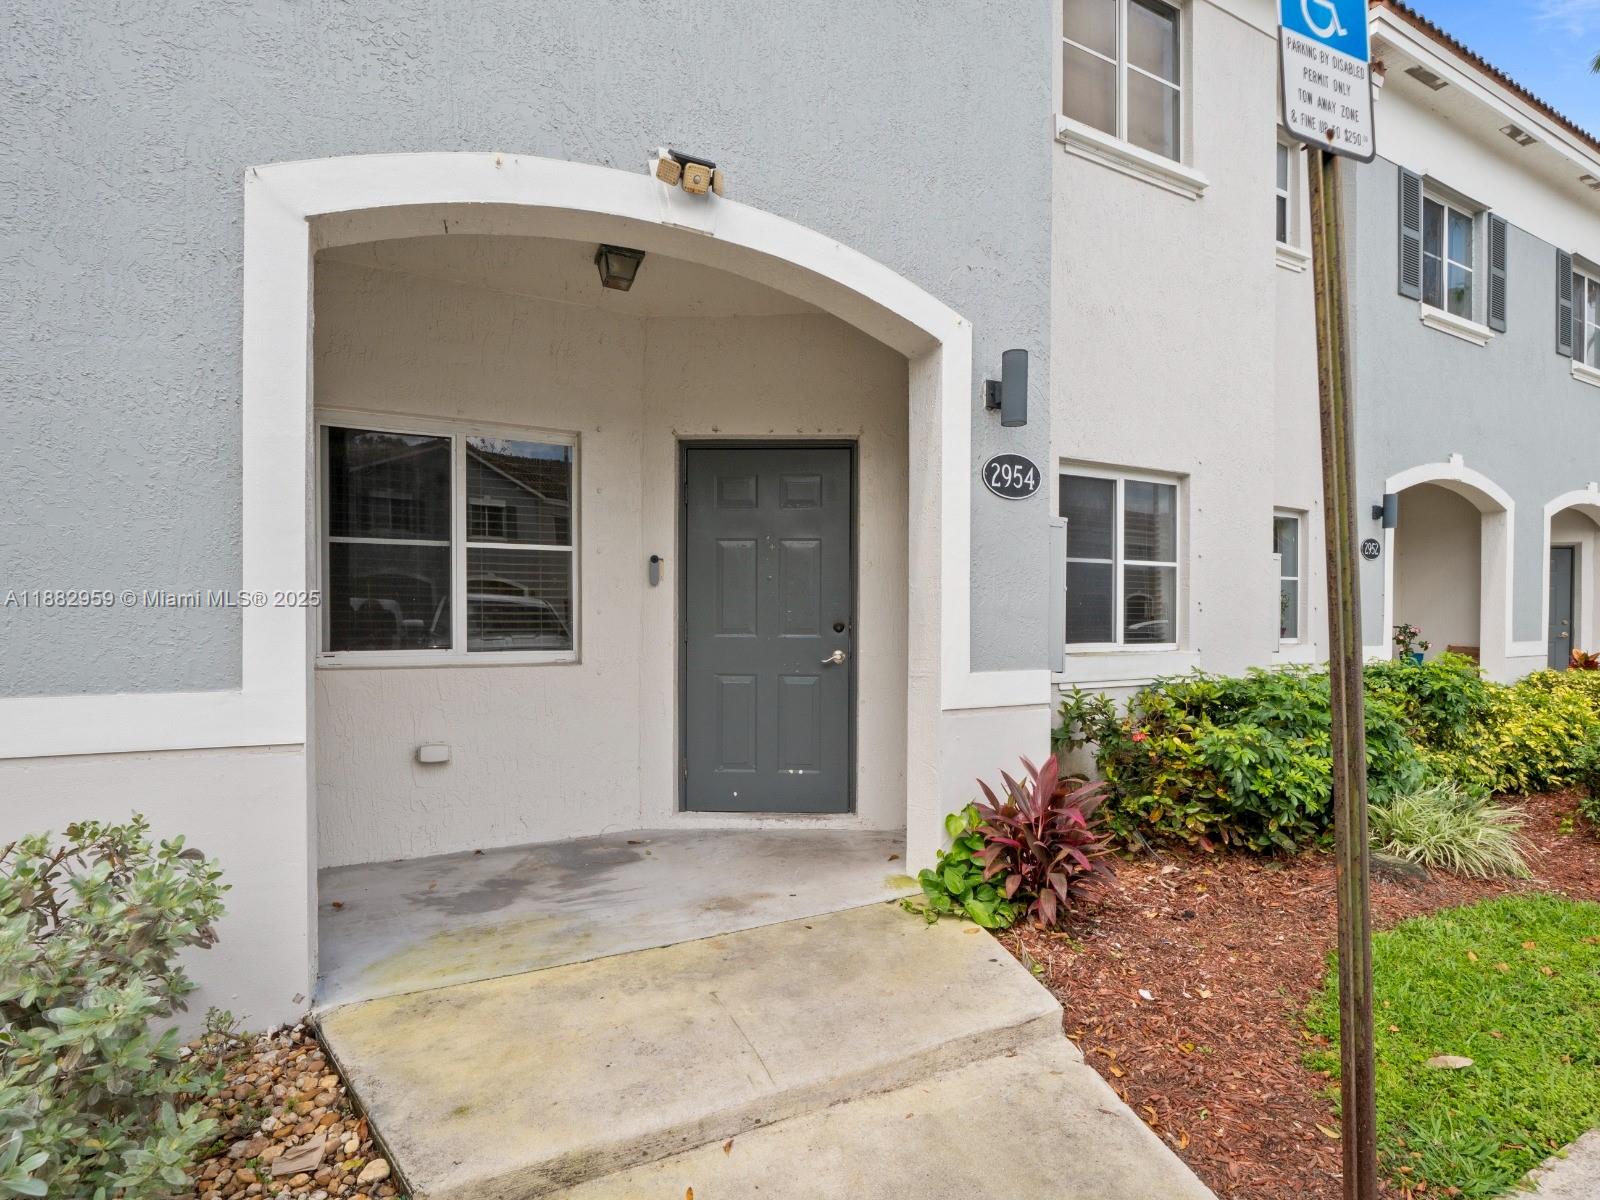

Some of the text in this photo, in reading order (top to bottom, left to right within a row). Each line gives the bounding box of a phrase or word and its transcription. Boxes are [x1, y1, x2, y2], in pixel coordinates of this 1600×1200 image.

[1287, 36, 1365, 80] PARKING BY DISABLED
[1303, 67, 1351, 96] PERMIT ONLY
[1298, 88, 1359, 123] TOW AWAY ZONE
[1291, 109, 1297, 123] &
[1301, 113, 1316, 130] FINE
[1319, 120, 1329, 134] UP
[991, 463, 1035, 490] 2954
[1365, 542, 1378, 555] 2952
